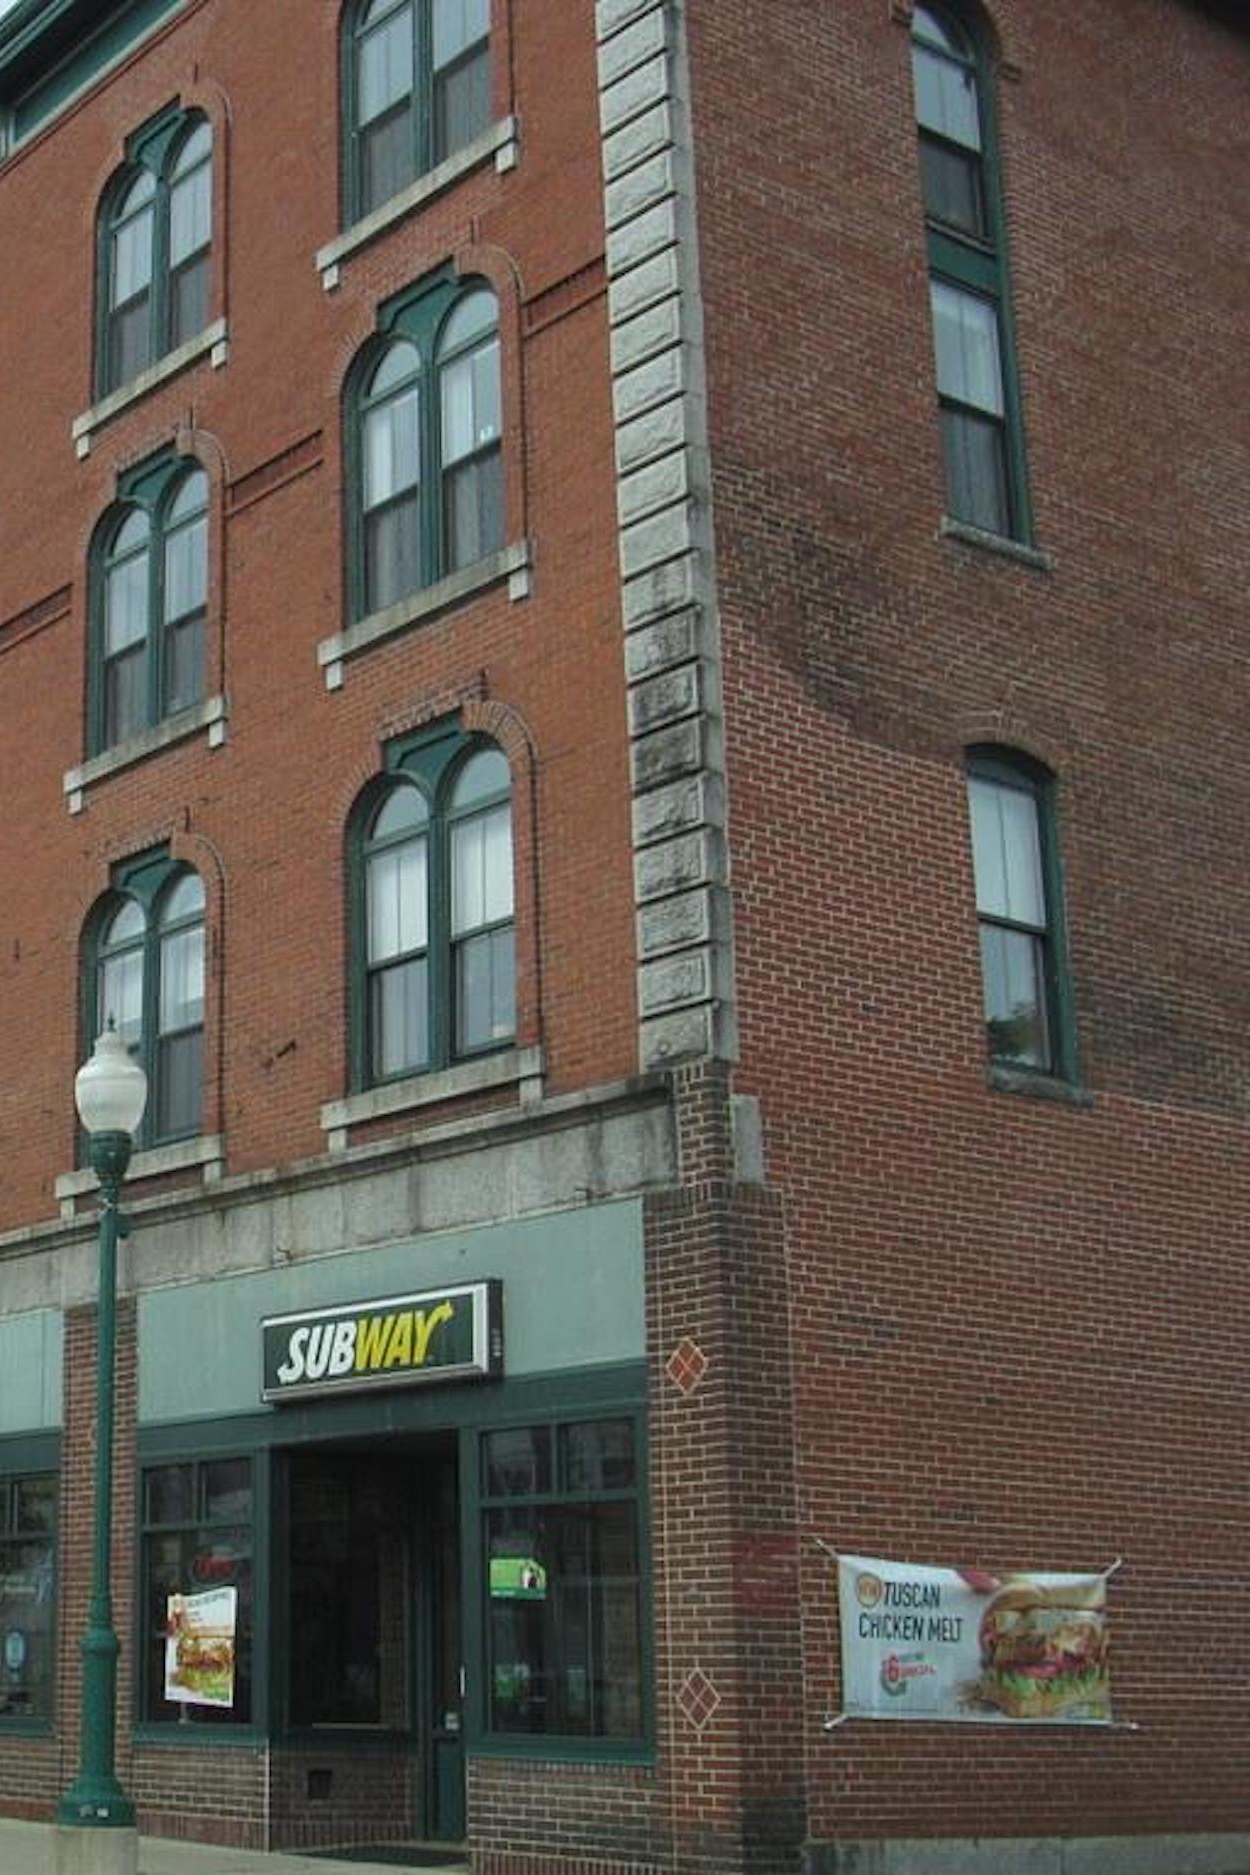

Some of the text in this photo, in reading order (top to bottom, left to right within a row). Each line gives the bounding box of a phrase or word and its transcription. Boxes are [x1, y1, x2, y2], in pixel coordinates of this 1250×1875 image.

[277, 1302, 454, 1384] SUBWAY
[884, 1582, 941, 1608] TUSCAN
[859, 1613, 963, 1643] CHICKEN MELT
